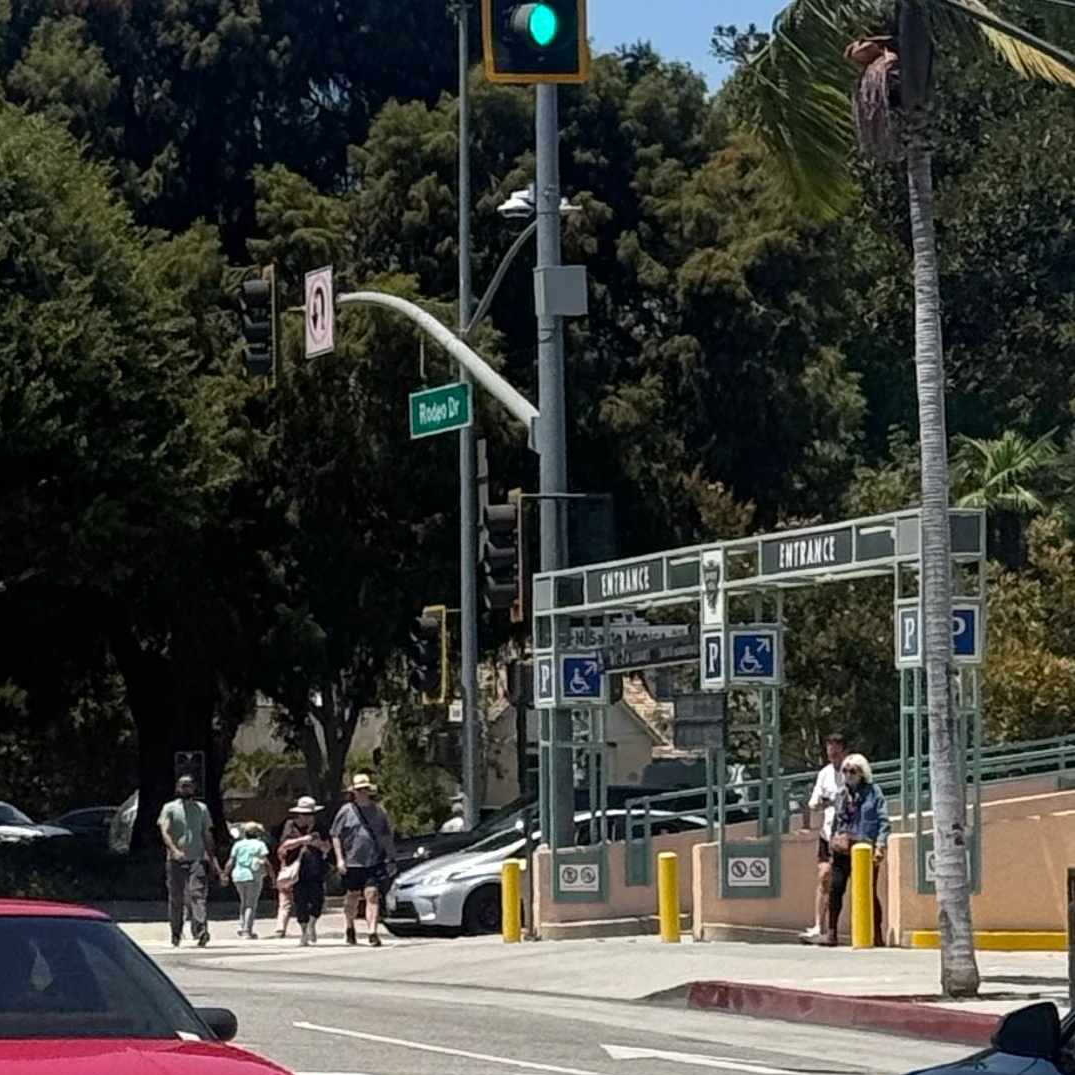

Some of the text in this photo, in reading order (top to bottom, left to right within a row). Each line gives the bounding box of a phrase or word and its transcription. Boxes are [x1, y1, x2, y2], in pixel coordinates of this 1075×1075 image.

[419, 396, 461, 425] Rodeo Dr
[779, 535, 835, 568] ENTRANCE
[601, 565, 650, 597] ENTRANCE
[904, 617, 916, 650] P
[708, 642, 719, 673] P
[541, 664, 550, 693] P
